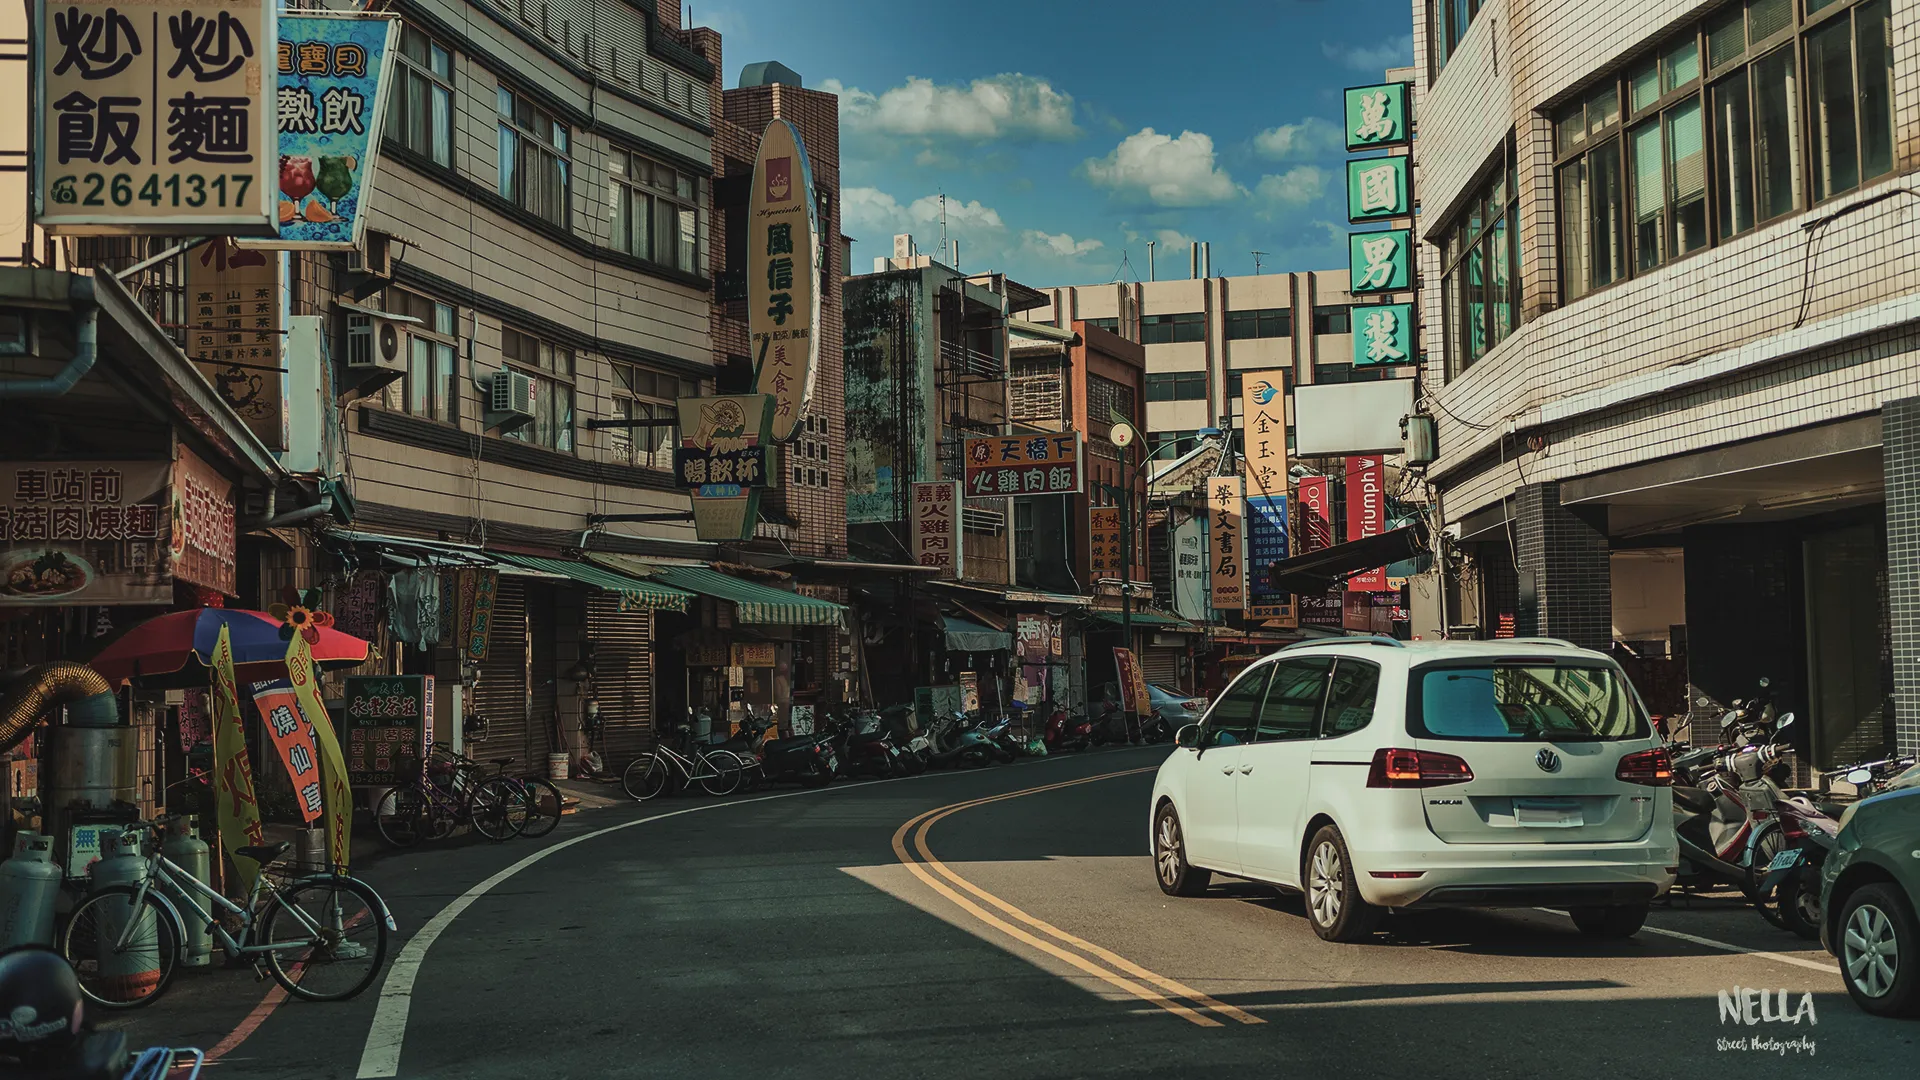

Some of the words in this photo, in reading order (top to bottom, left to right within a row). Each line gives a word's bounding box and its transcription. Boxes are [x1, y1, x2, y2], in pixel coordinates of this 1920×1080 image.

[53, 6, 143, 165] 炒飯
[167, 9, 254, 164] 炒麵
[82, 173, 254, 207] 2641317
[757, 205, 802, 219] Hyacinth
[1355, 91, 1406, 362] 萬國男裝
[767, 222, 794, 326] 風信子
[771, 344, 794, 418] 美食坊
[972, 466, 1072, 494] 火雞肉飯
[1000, 436, 1074, 462] 天橋下
[1253, 410, 1279, 489] 金玉堂
[15, 467, 123, 503] 車站前
[917, 484, 952, 503] 嘉義
[1307, 486, 1320, 552] HISEIDO
[1360, 471, 1379, 541] Triumph
[919, 503, 950, 567] 火雞肉飯
[1214, 484, 1237, 578] 榮文書局
[270, 704, 323, 814] 燒仙草
[351, 728, 416, 742] 高山茗茶
